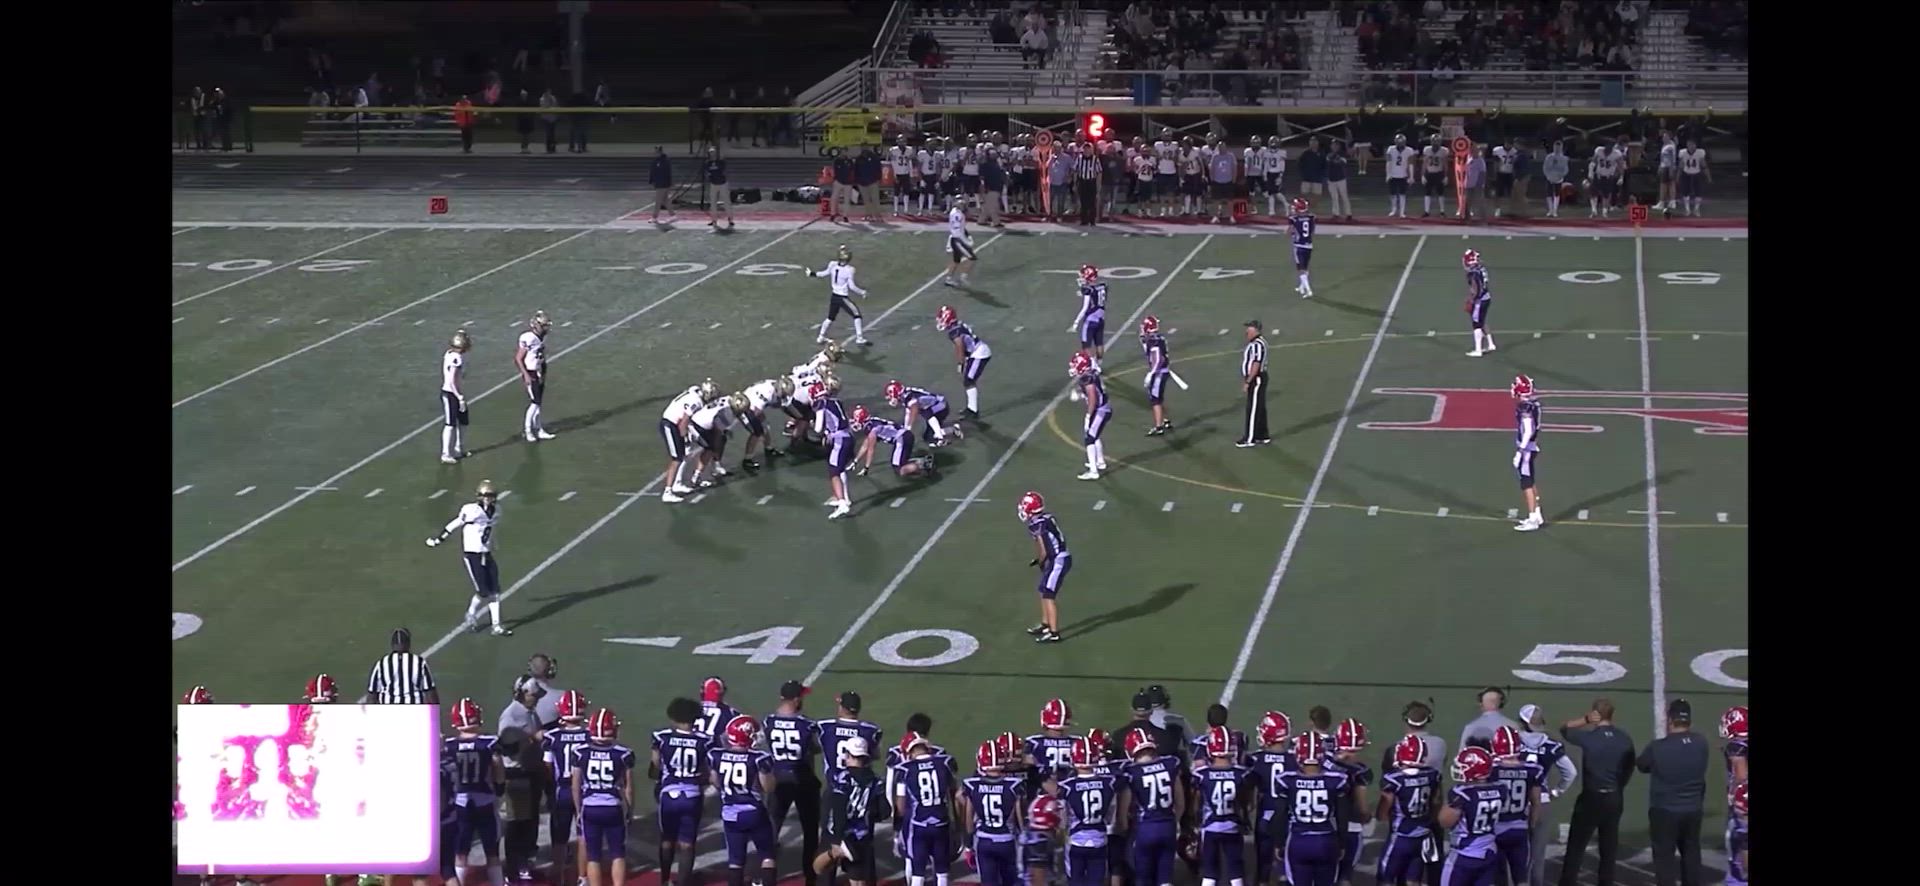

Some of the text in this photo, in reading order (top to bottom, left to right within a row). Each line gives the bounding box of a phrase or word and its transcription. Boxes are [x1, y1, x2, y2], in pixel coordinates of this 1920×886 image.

[1089, 114, 1103, 138] 2
[1302, 221, 1309, 237] 9
[1632, 206, 1647, 220] 50
[770, 729, 801, 761] 25
[456, 751, 480, 785] 77
[669, 747, 698, 778] 40
[719, 762, 749, 796] 79
[917, 769, 941, 807] 81
[1141, 771, 1173, 810] 75
[1211, 780, 1236, 816] 42
[982, 794, 1004, 828] 15
[1081, 789, 1103, 825] 12
[1294, 789, 1329, 823] 85
[1473, 800, 1502, 835] 63
